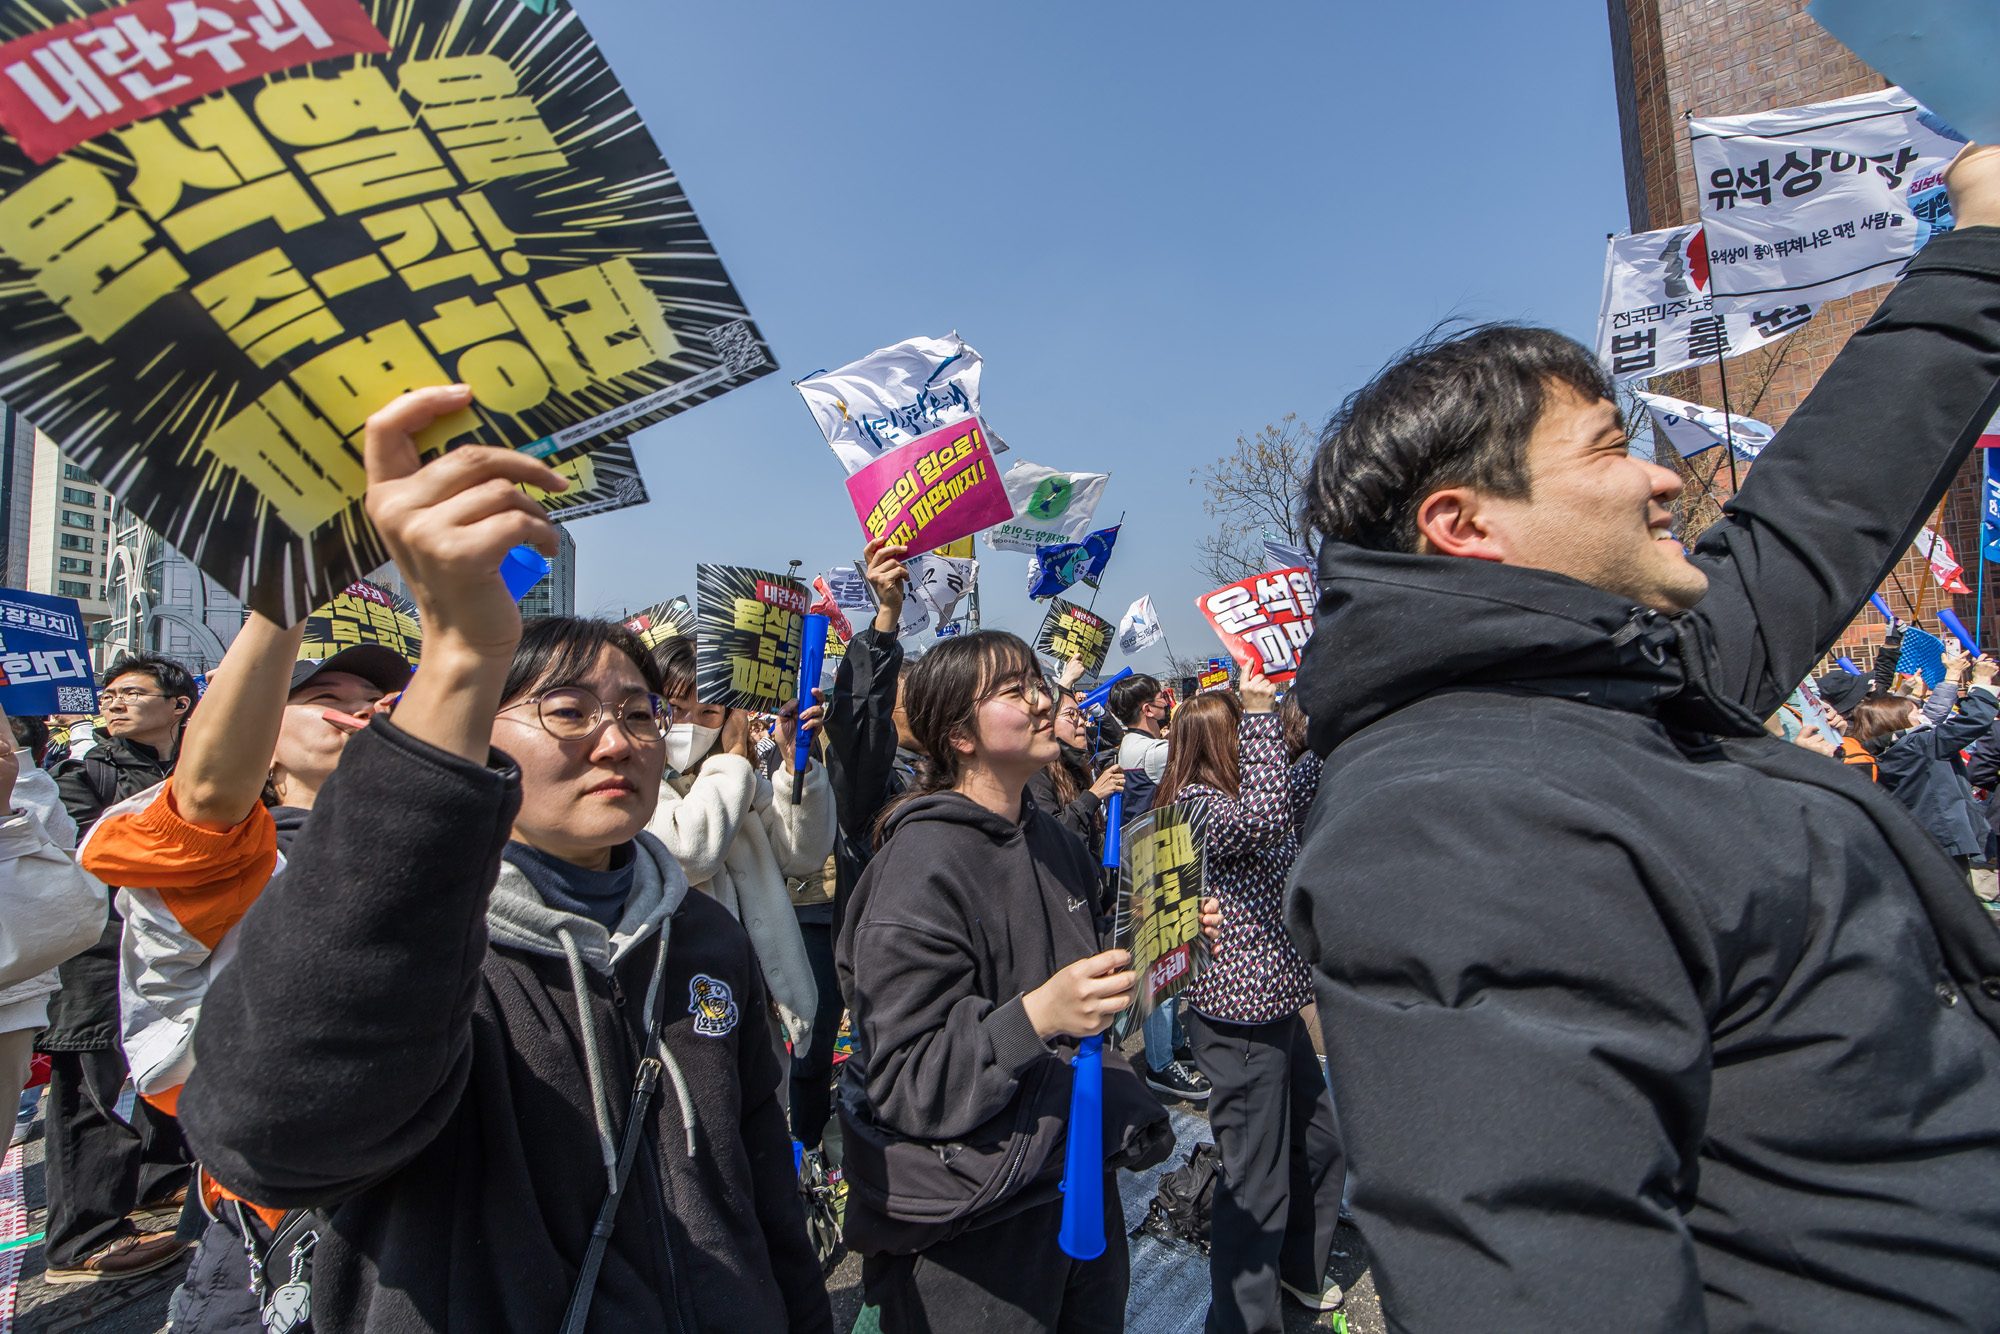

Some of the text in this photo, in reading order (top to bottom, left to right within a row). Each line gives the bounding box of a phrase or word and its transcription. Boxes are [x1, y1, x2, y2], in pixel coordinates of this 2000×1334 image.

[5, 0, 334, 123] 내란수괴
[0, 52, 569, 344] 윤석열을
[1710, 246, 1748, 265] 유석상이
[1753, 244, 1773, 260] 좋아
[1774, 229, 1832, 257] 뛰쳐나온
[1833, 221, 1856, 239] 대전
[203, 257, 682, 539] 파면하라
[865, 428, 982, 539] 평등의 힘으로!
[908, 459, 987, 531] 파면까지!
[0, 649, 87, 685] 한다
[1059, 613, 1105, 647] 윤석열을
